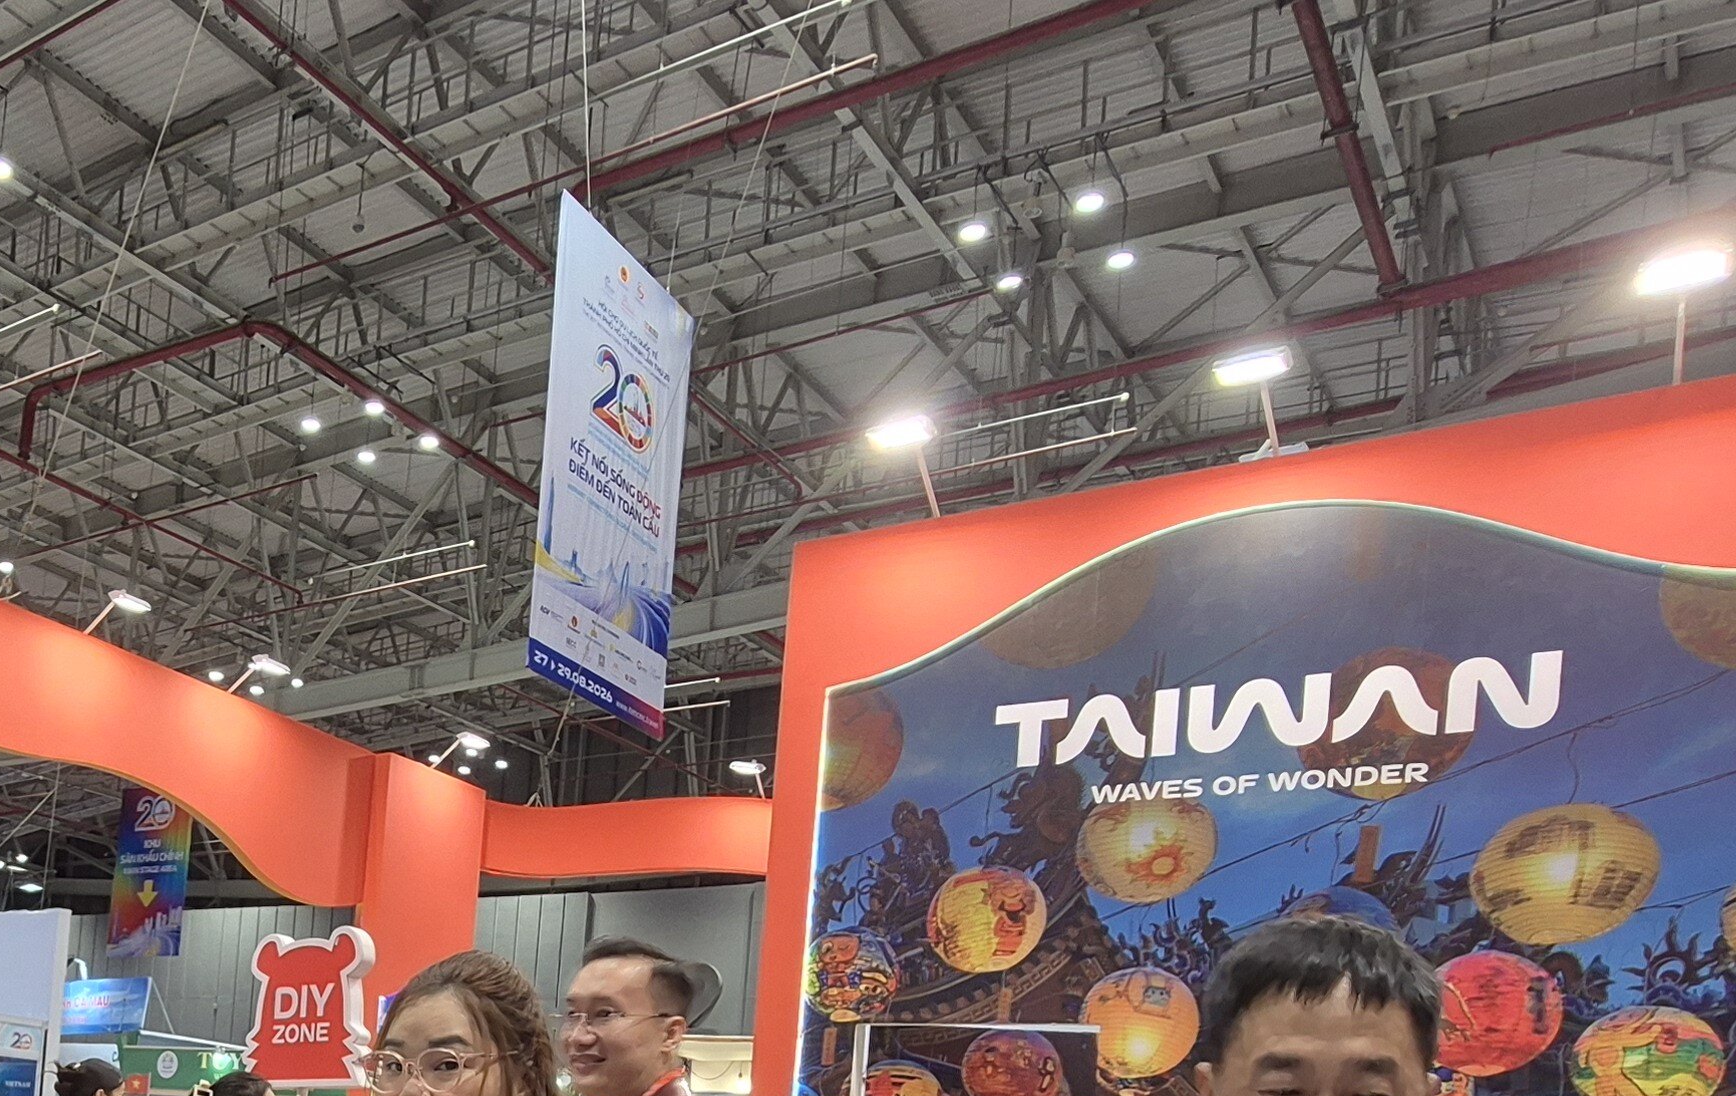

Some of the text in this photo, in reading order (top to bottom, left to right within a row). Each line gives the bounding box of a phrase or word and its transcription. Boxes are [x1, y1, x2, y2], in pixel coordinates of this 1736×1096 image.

[590, 344, 656, 454] 20
[568, 458, 596, 488] ĐIỂM
[596, 478, 616, 504] ĐẾN
[617, 494, 643, 525] TOÀN
[642, 513, 661, 538] CẦU
[570, 437, 591, 466] KẾT
[592, 456, 609, 478] NỐI
[610, 468, 636, 499] SỐNG
[636, 490, 662, 520] ĐỘNG
[533, 650, 549, 667] 27
[557, 664, 613, 703] 29.08.2026
[995, 650, 1564, 768] TAIWAN
[1092, 762, 1429, 805] WAVES OF WONDER
[134, 795, 176, 832] 20
[274, 982, 335, 1020] DIY
[271, 1022, 330, 1044] ZONE
